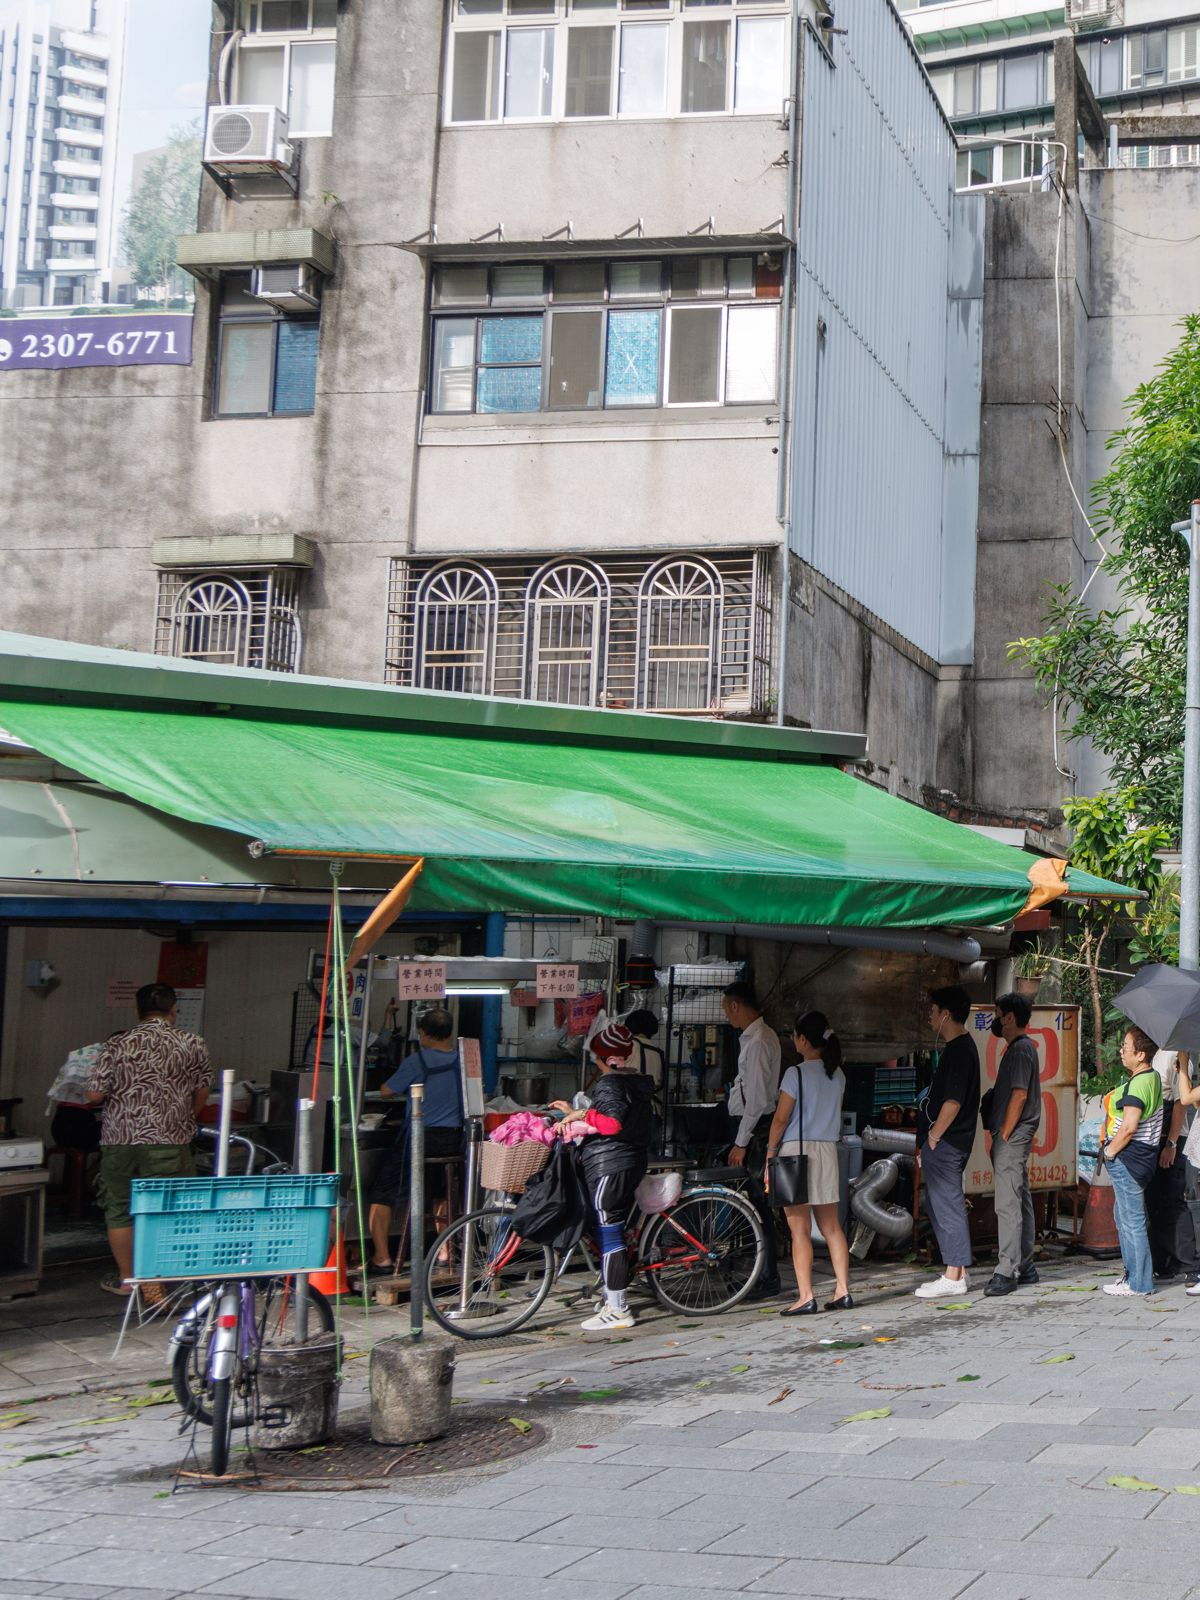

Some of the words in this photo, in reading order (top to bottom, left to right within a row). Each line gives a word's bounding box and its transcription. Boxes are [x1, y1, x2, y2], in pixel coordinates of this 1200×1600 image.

[20, 330, 179, 359] 2307-6771
[402, 967, 443, 979] 營業時間
[540, 968, 576, 979] 營業時間
[1027, 1164, 1068, 1183] 521428
